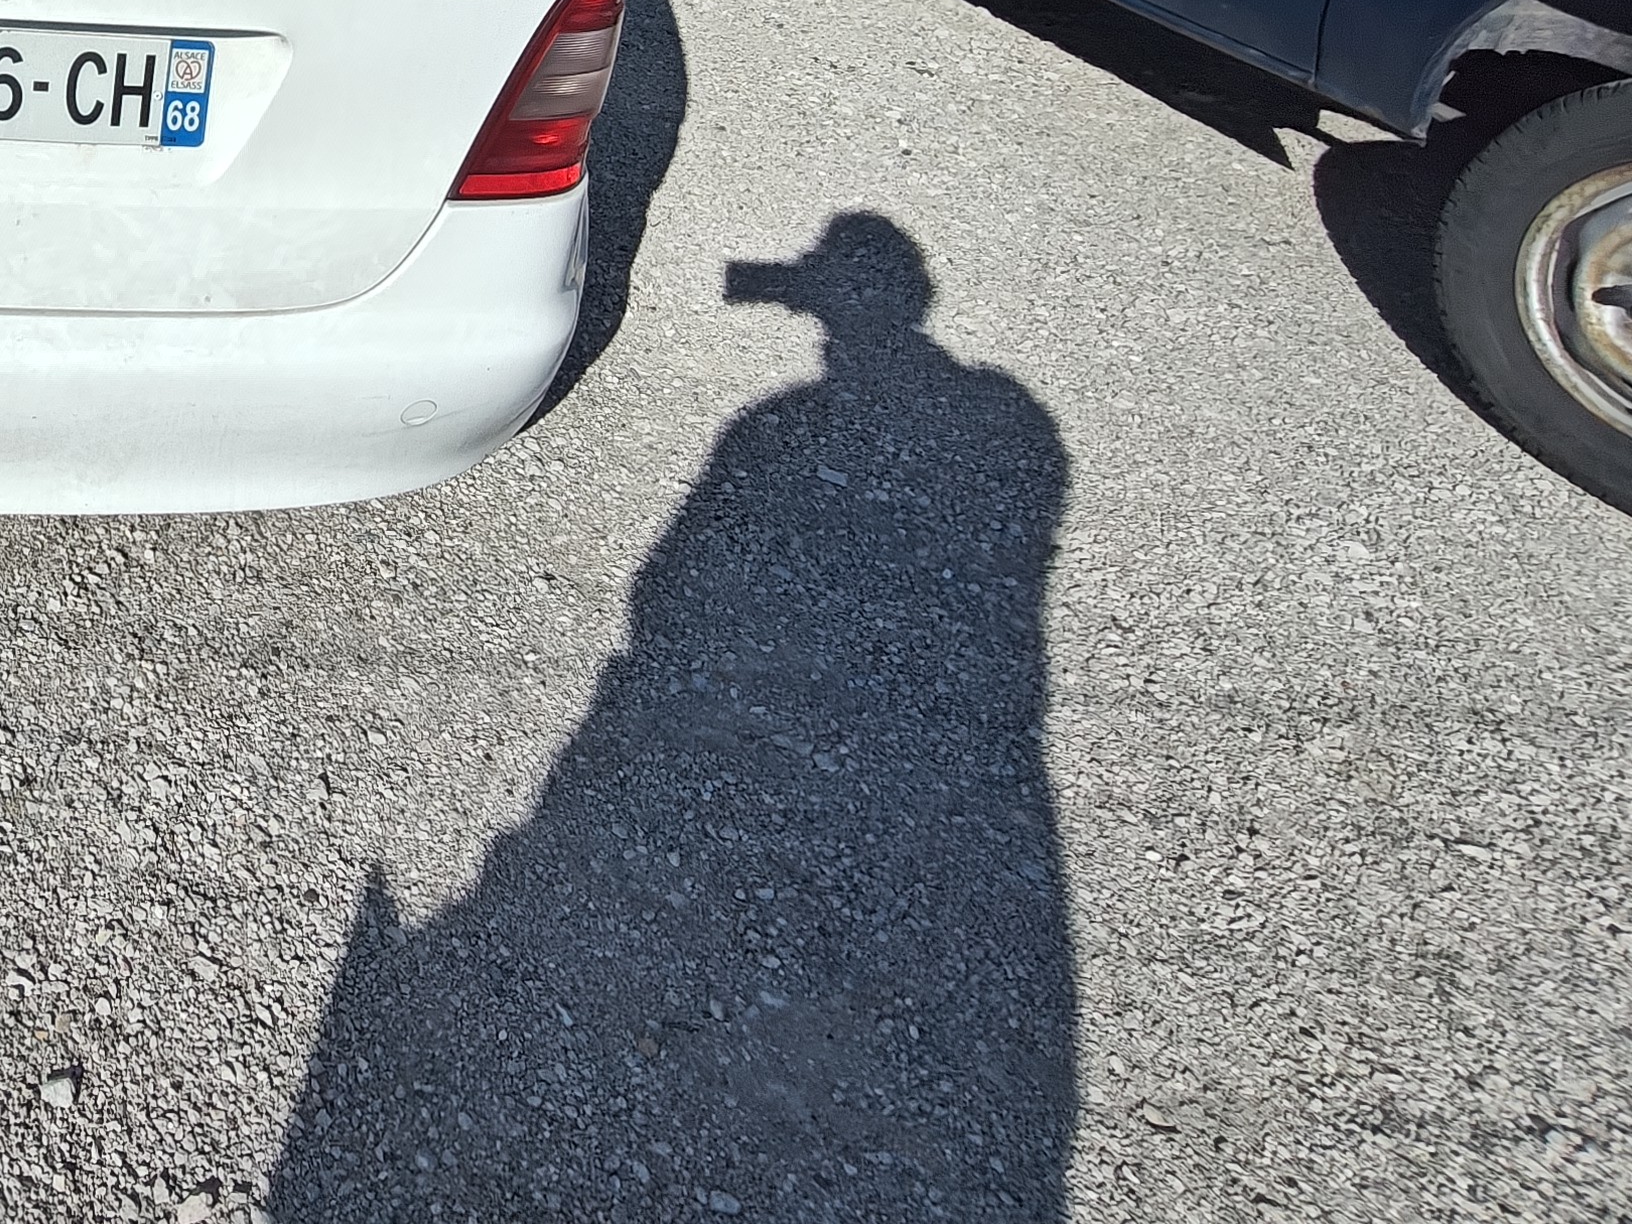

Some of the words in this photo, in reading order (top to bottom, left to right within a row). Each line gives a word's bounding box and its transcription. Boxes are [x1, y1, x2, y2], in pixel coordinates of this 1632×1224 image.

[173, 50, 207, 61] ALSACE
[170, 80, 203, 90] ELSASS
[166, 99, 201, 132] 68
